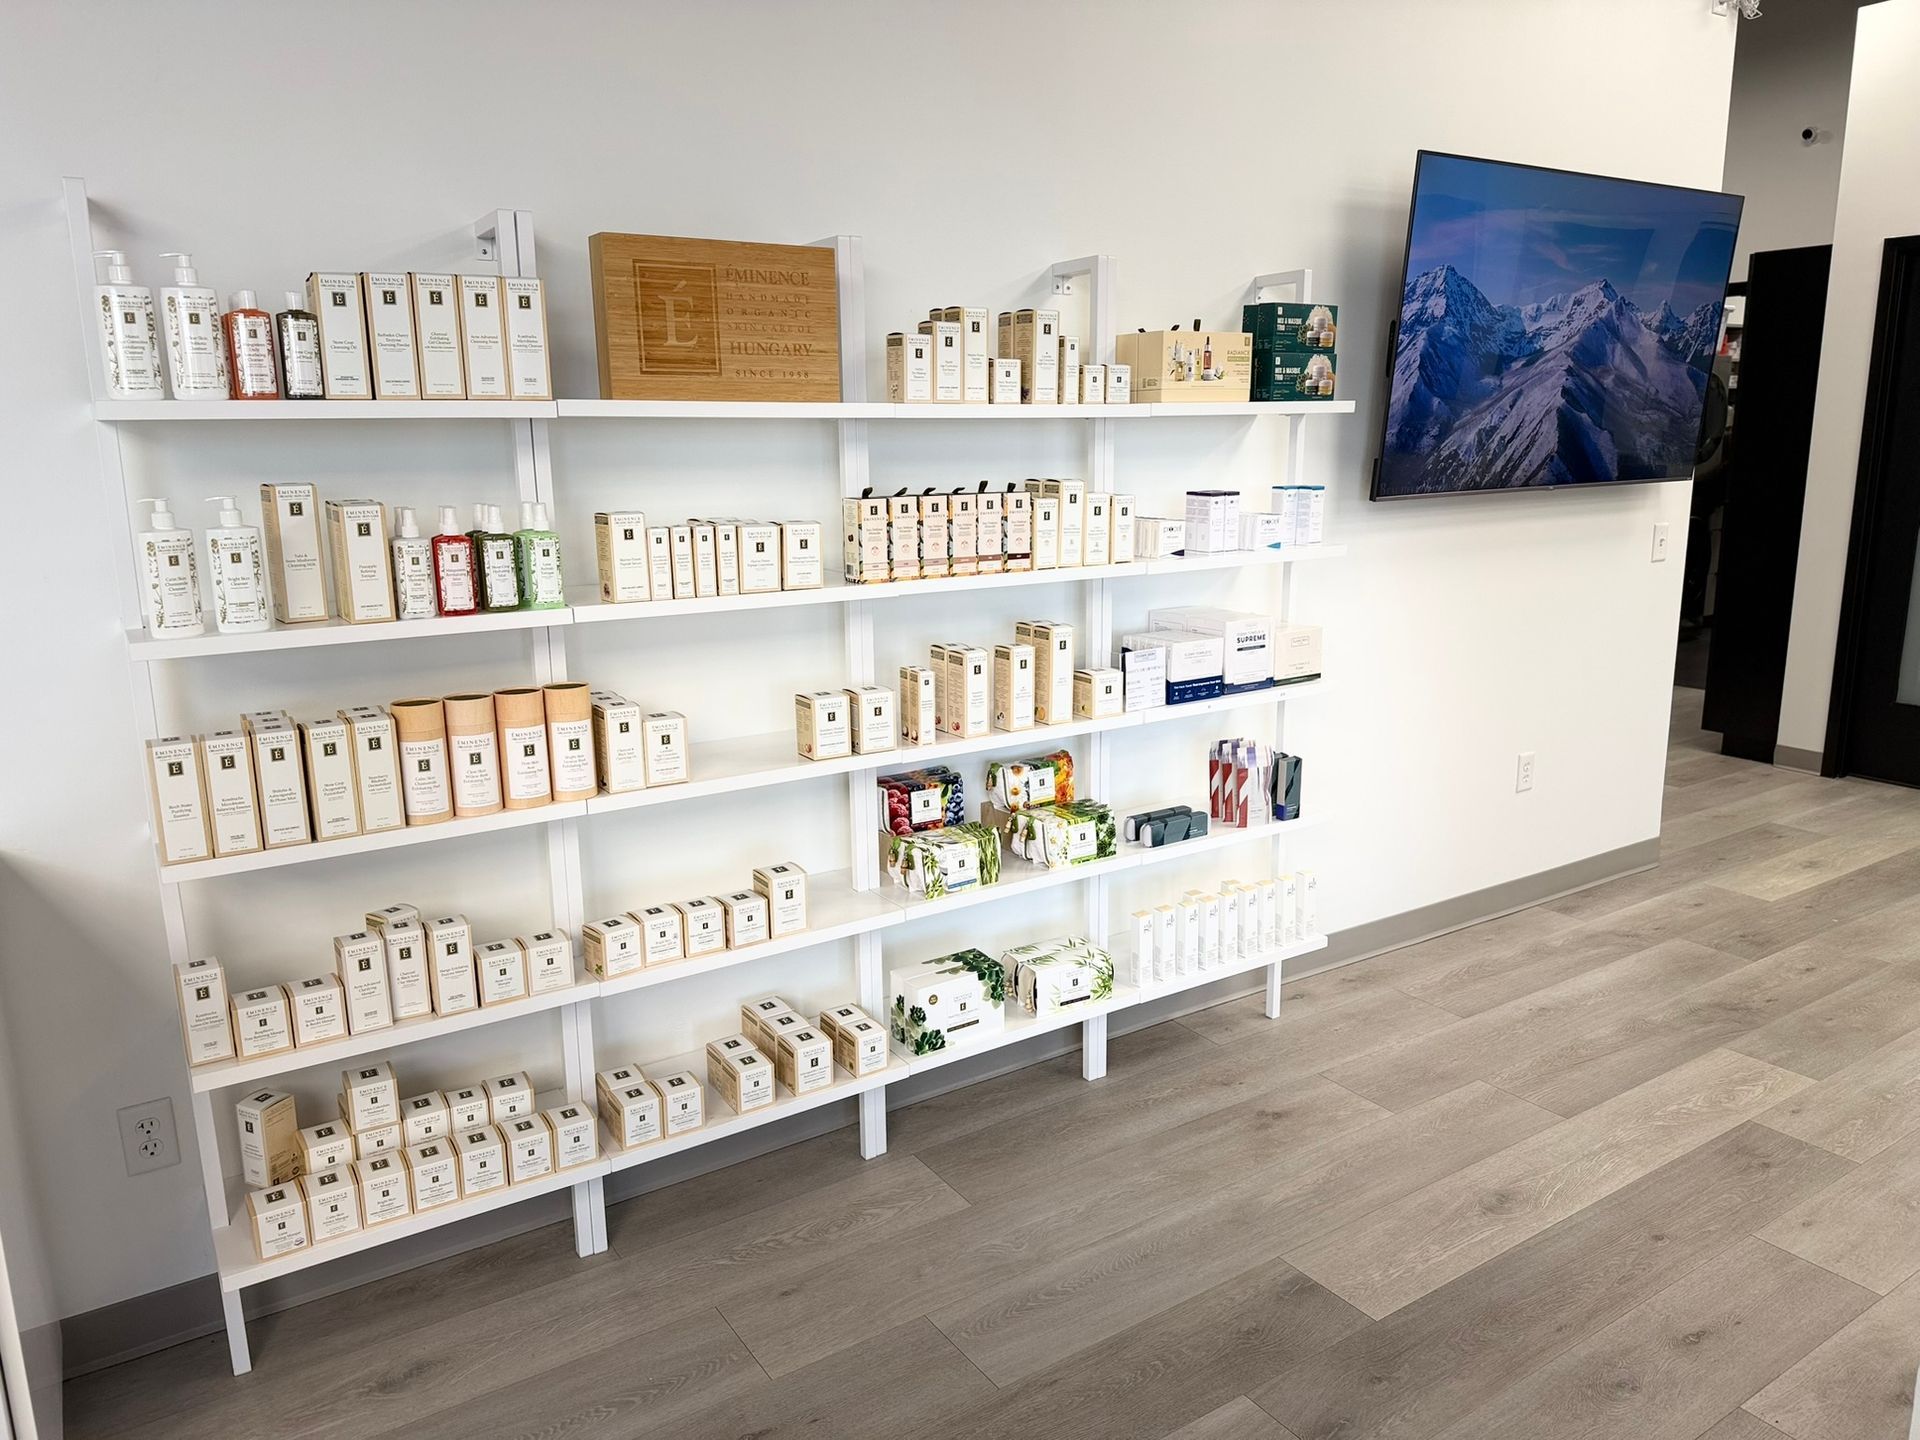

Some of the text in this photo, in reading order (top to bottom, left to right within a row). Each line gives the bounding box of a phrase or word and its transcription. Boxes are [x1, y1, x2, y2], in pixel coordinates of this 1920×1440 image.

[725, 264, 809, 286] ÉMINENCE
[727, 308, 811, 318] ORGANIC
[730, 341, 812, 356] HUNGARY
[736, 370, 774, 378] SINCE
[1237, 634, 1266, 644] SUPREME
